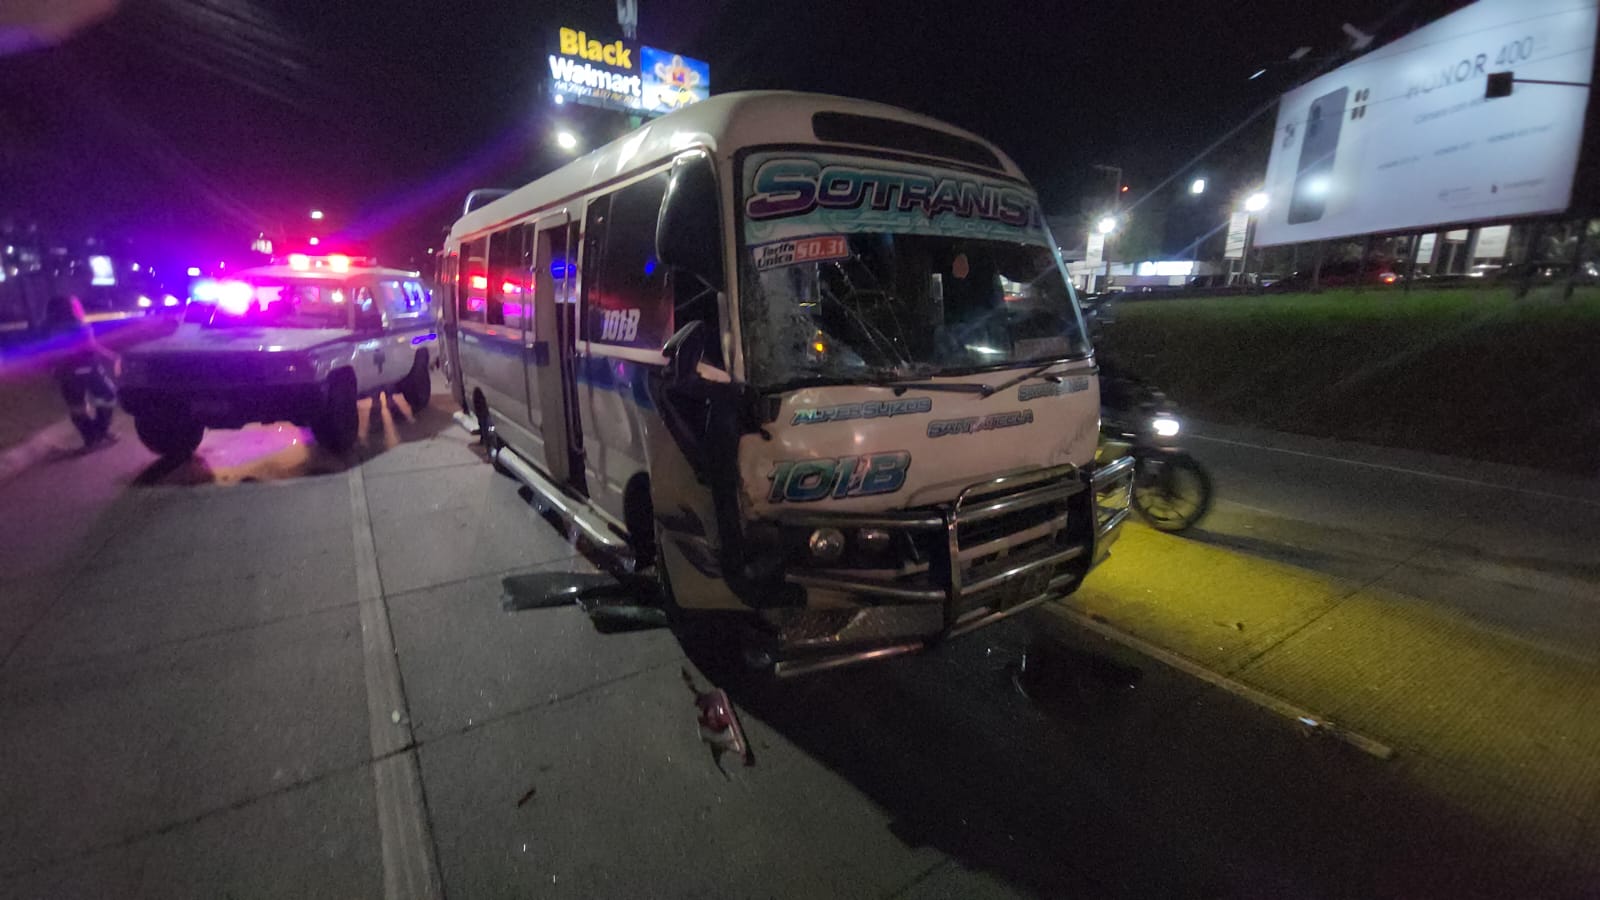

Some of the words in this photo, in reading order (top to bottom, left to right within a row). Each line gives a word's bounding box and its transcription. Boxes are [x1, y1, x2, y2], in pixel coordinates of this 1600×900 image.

[560, 27, 632, 69] Black
[1495, 35, 1535, 66] 400
[548, 54, 641, 97] Walmart
[762, 243, 795, 257] Tarifa
